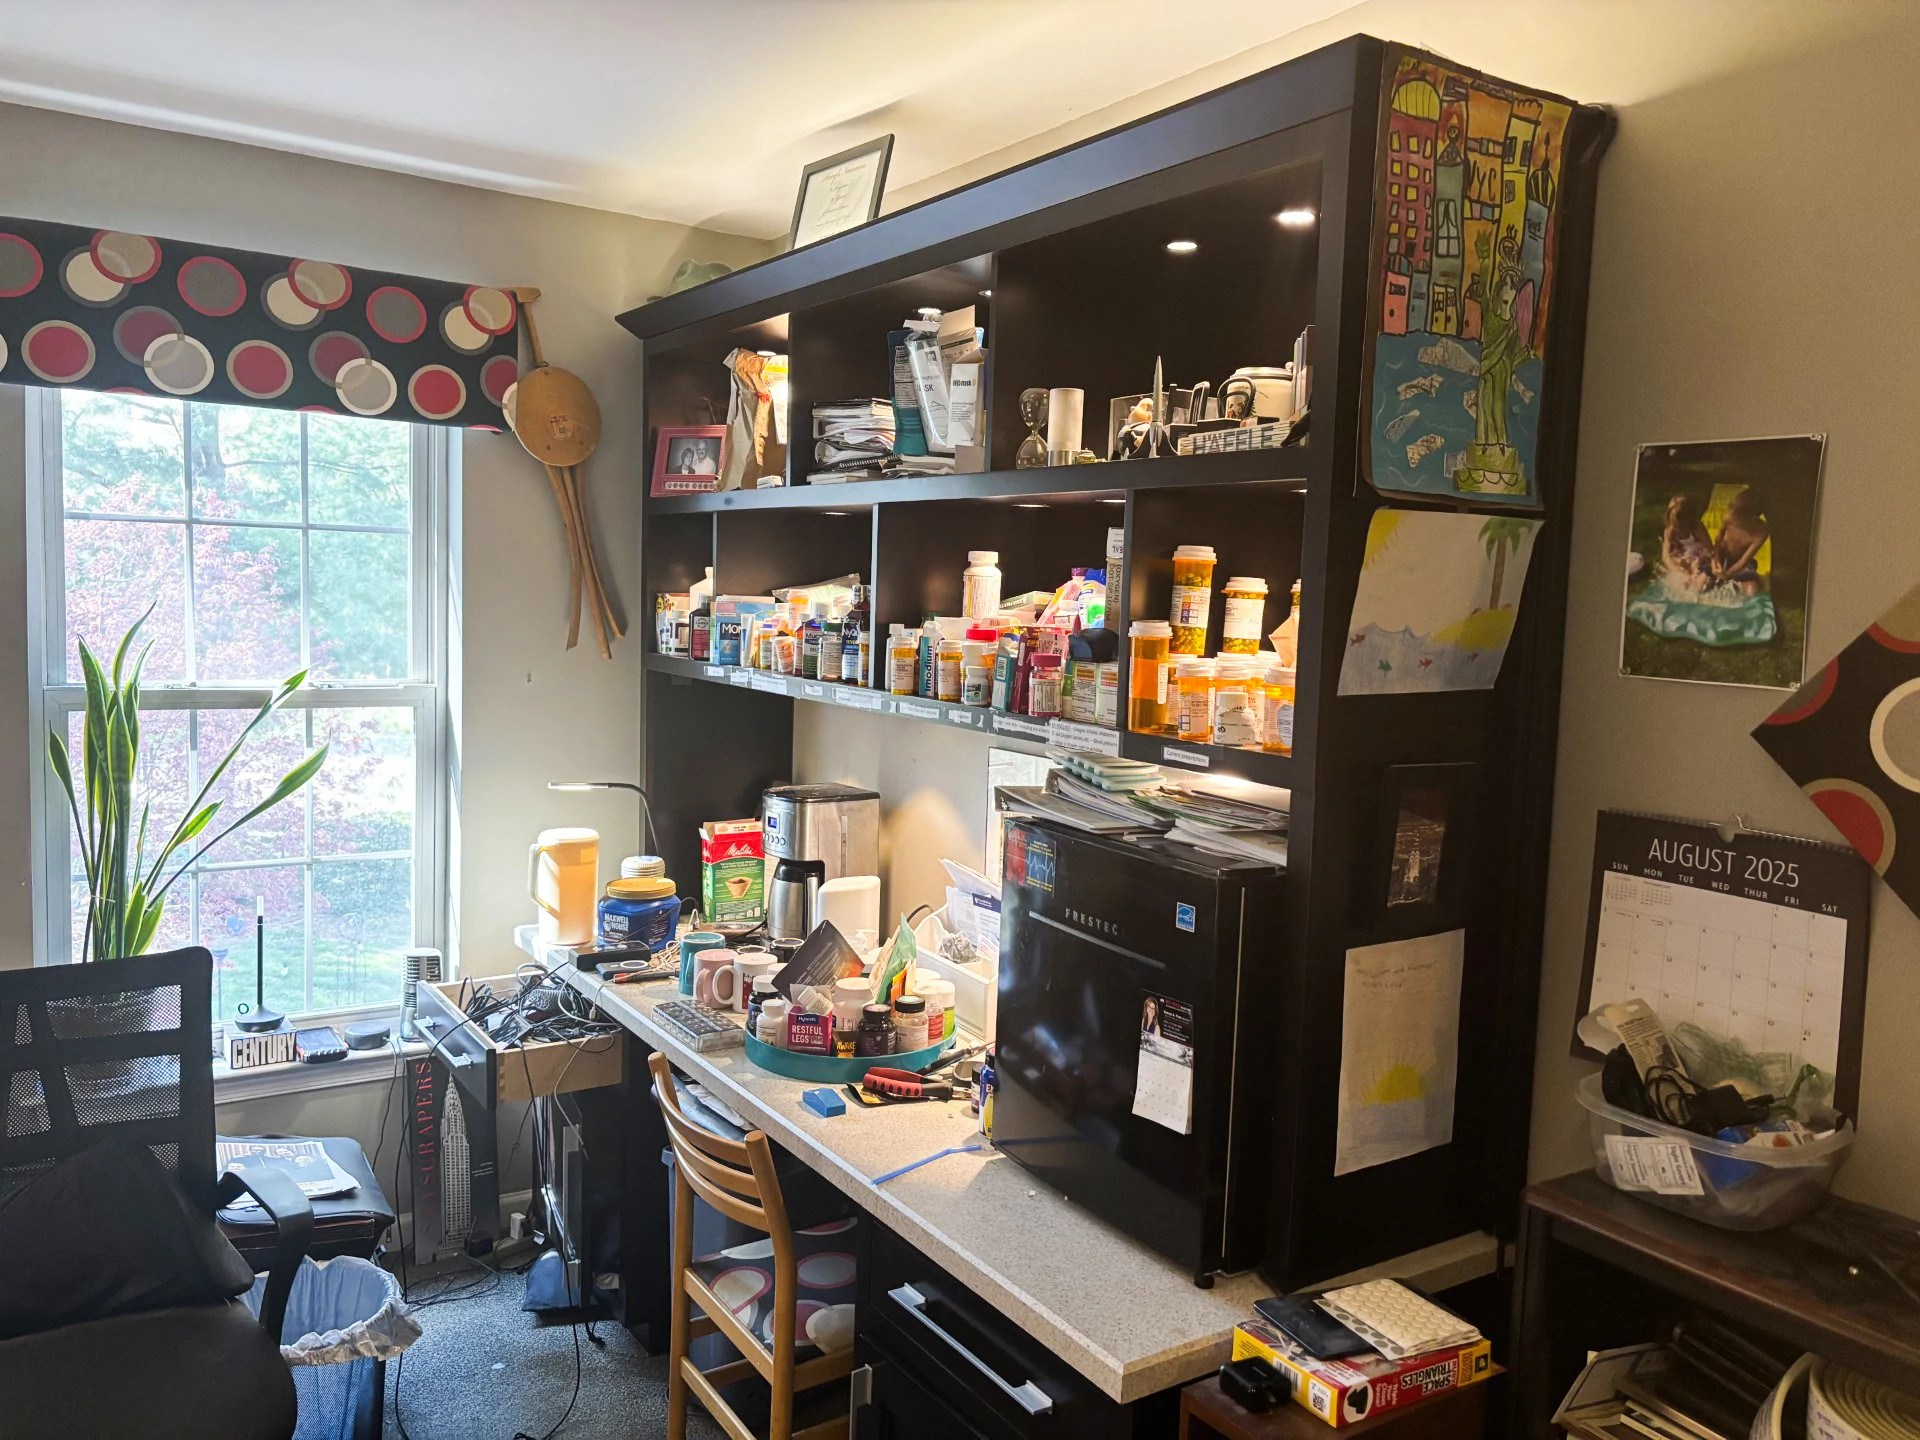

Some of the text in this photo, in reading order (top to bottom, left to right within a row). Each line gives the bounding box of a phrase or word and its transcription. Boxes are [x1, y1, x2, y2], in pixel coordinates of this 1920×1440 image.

[924, 645, 932, 692] Imodium
[1166, 750, 1207, 763] Current prescriptions
[724, 843, 754, 858] Melitta
[1648, 838, 1800, 889] AUGUST 2025
[1612, 862, 1839, 914] SUN MON TUE WED THUR FRI SAT
[604, 912, 629, 924] MAXWELL
[611, 922, 629, 931] HOUSE
[1065, 907, 1118, 936] FRESTEC
[791, 1025, 823, 1035] RESTFUL
[791, 1034, 809, 1044] LEGS
[232, 1032, 296, 1069] CENTURY
[1401, 1361, 1451, 1389] TRIANGLES
[1422, 1375, 1451, 1394] SPACE
